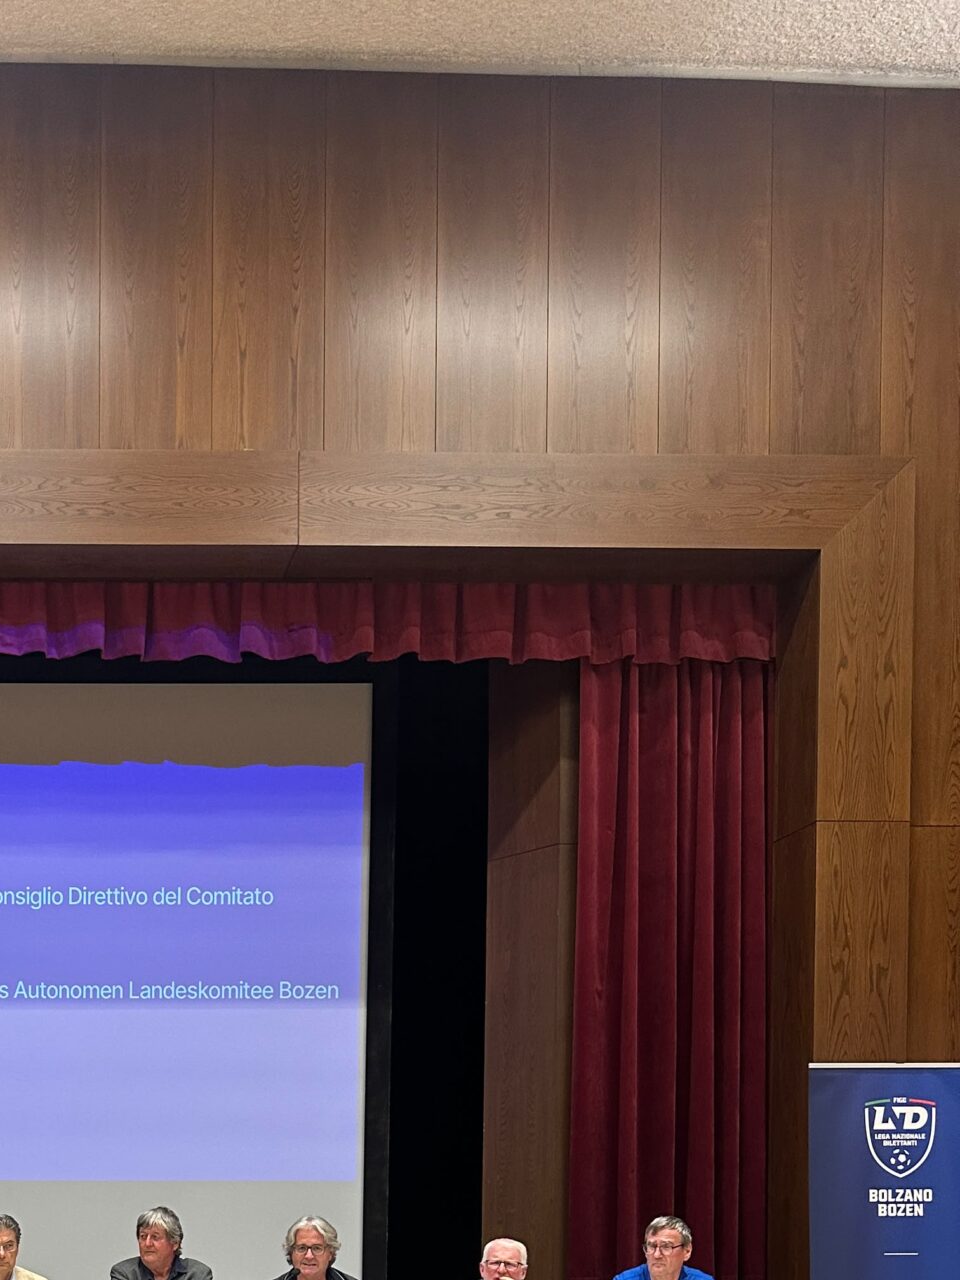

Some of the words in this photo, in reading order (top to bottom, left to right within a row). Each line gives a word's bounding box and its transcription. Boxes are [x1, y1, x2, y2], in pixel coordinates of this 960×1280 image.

[69, 886, 147, 906] Direttivo
[153, 886, 182, 906] del
[187, 886, 274, 906] Comitato
[14, 981, 124, 999] Autonomen
[130, 981, 274, 1000] Landeskomitee
[280, 981, 340, 1000] Bozen
[873, 1106, 929, 1130] LND
[868, 1188, 933, 1203] BOLZANO
[877, 1203, 924, 1217] BOZEN
